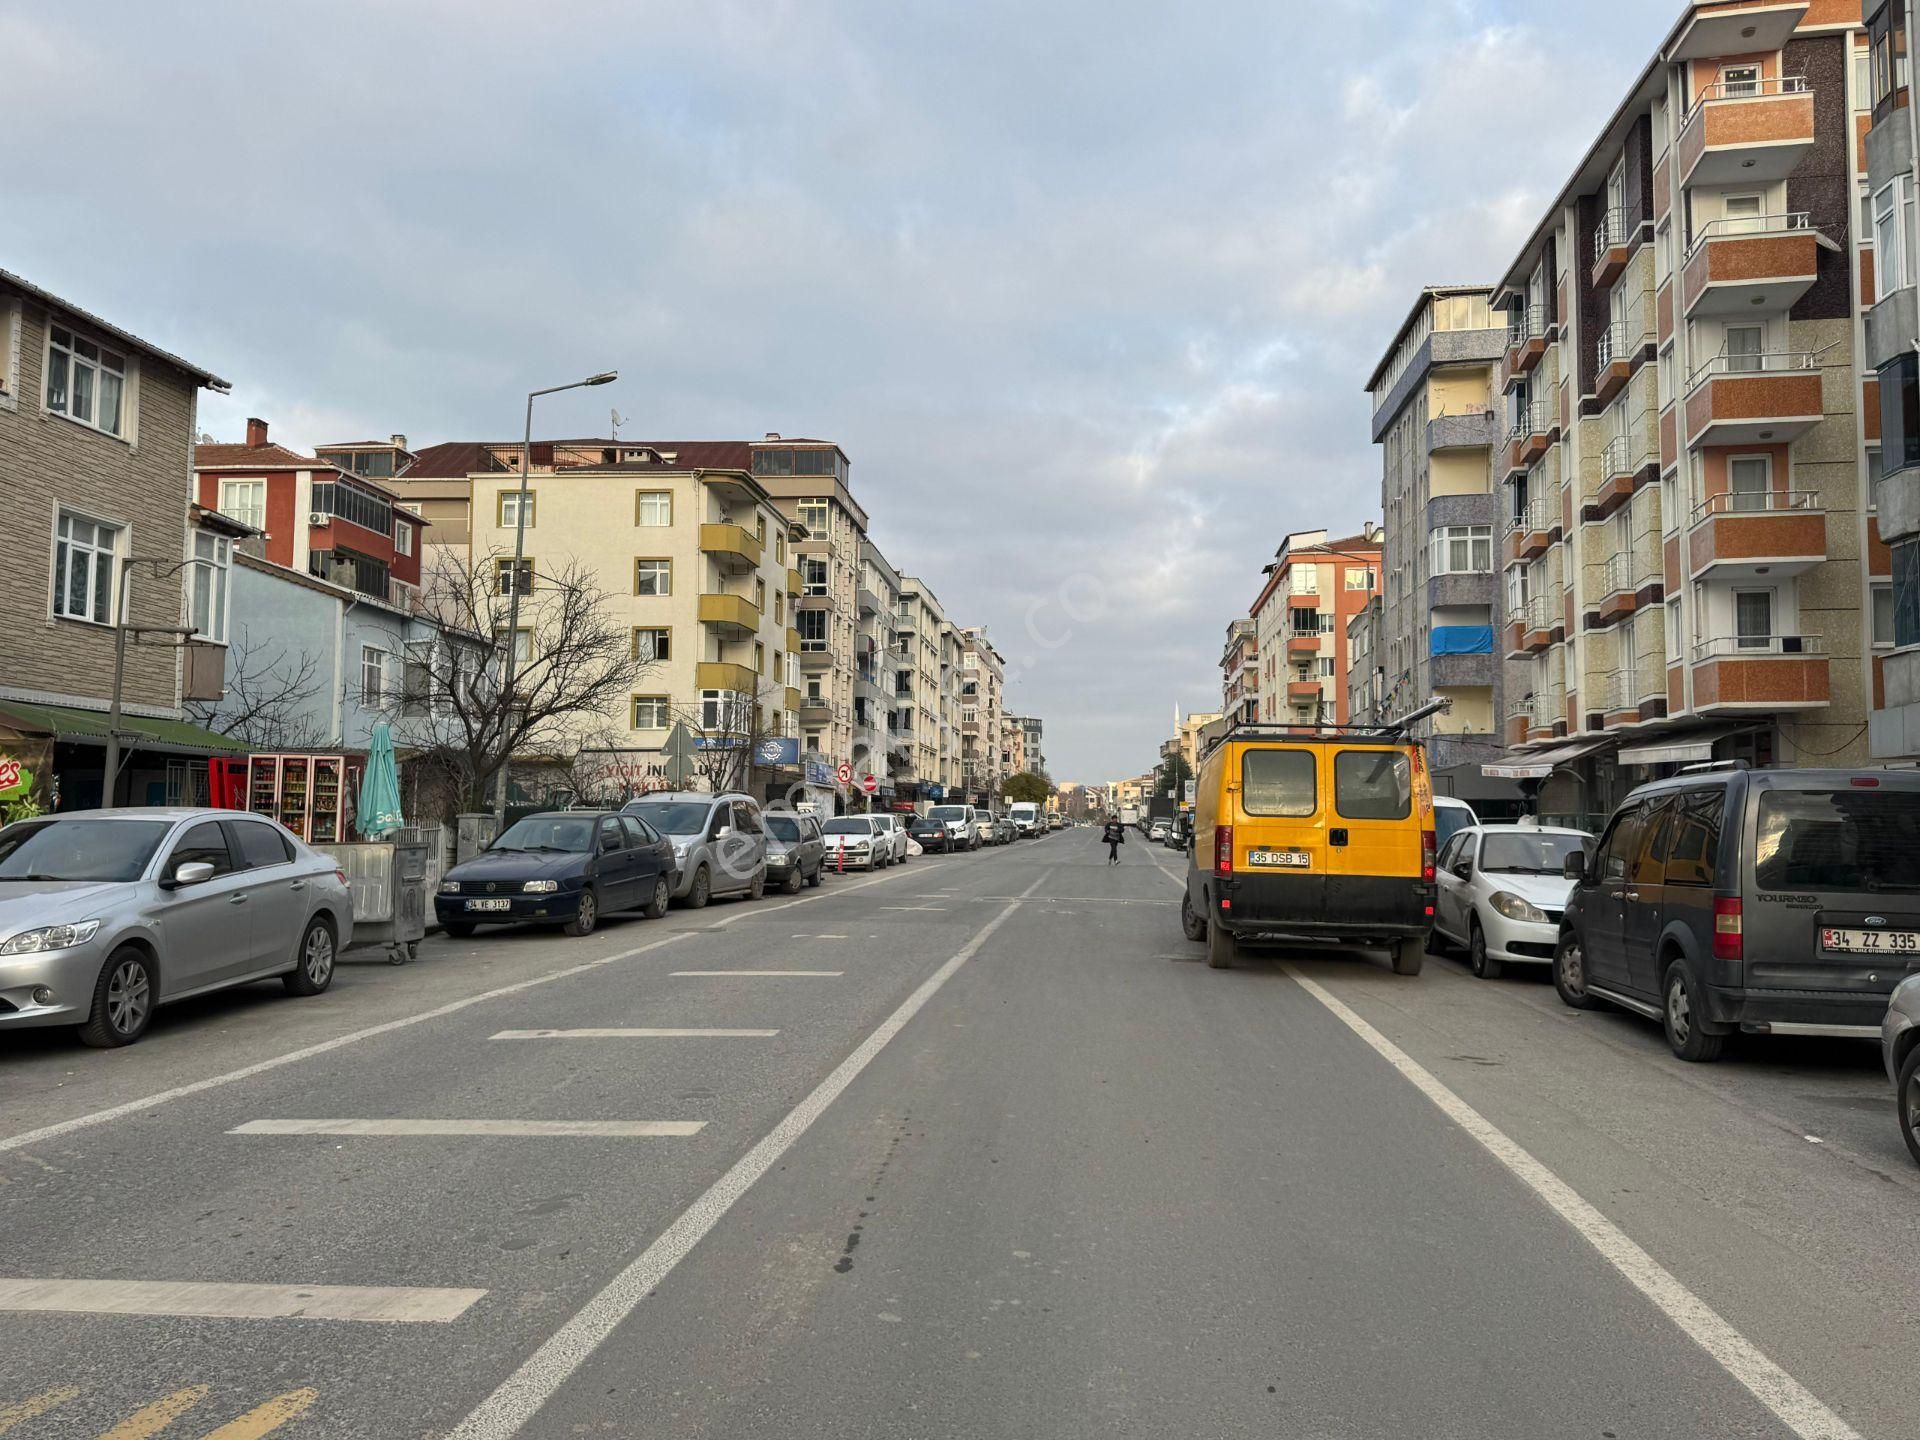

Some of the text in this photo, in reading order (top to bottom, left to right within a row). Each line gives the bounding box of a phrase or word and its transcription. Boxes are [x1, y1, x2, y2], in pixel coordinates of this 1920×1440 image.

[1255, 853, 1308, 864] 35 DSB 15
[470, 900, 477, 908] 34
[1756, 894, 1818, 904] TOURNEO
[1833, 931, 1850, 947] 34
[1862, 932, 1880, 947] ZZ
[1889, 933, 1916, 949] 335
